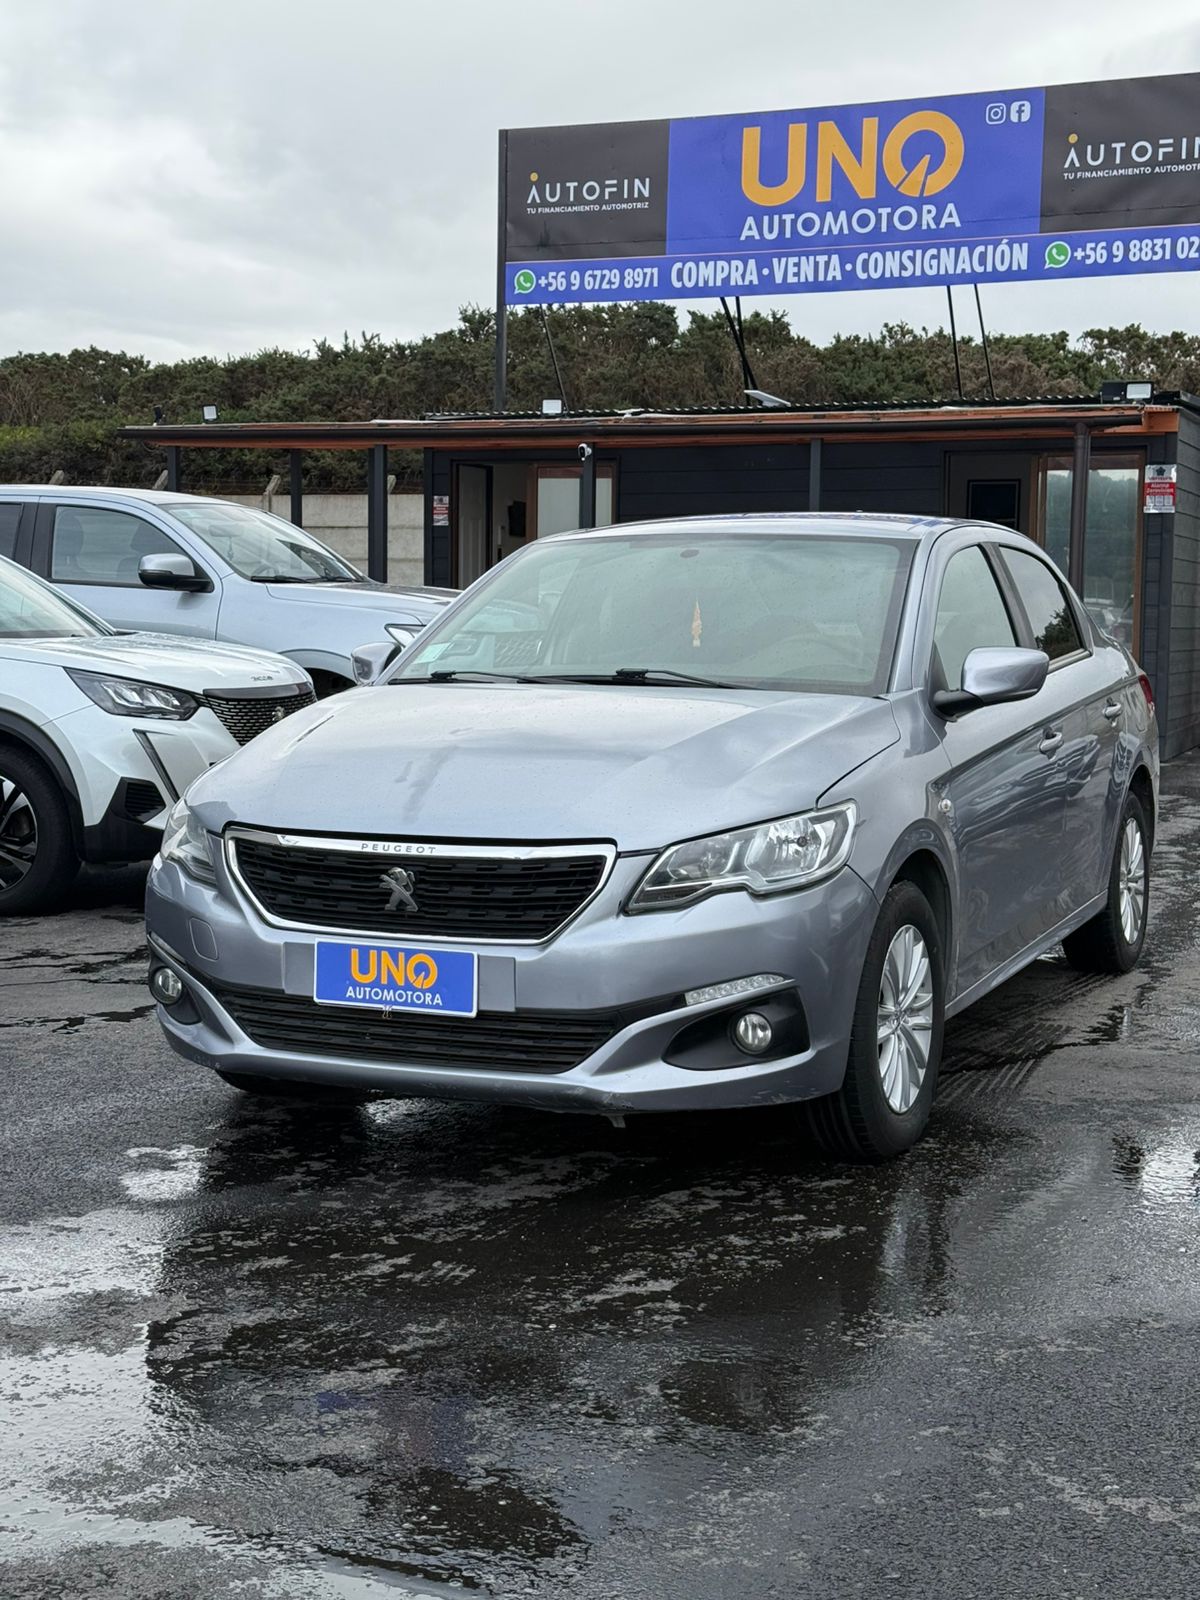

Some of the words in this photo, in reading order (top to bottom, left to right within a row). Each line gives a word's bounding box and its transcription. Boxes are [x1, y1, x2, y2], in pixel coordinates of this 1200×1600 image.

[741, 110, 965, 207] UNO
[1063, 172, 1075, 180] TU
[1077, 166, 1152, 178] FINANCIAMIENTO
[527, 177, 650, 204] AUTOFIN
[538, 204, 600, 214] FINANCIAMIENTO
[601, 202, 650, 211] AUTOMOTRIZ
[739, 202, 962, 241] AUTOMOTORA
[670, 258, 757, 289] COMPRA
[772, 254, 843, 285] VENTA
[855, 239, 1029, 280] CONSIGNACIÓN
[1073, 241, 1108, 265] +56
[1112, 240, 1124, 263] 9
[1128, 238, 1172, 262] 8831
[1176, 236, 1200, 260] 02
[538, 271, 567, 292] +56
[570, 270, 581, 291] 9
[584, 268, 620, 291] 6729
[624, 267, 659, 289] 8971
[361, 843, 437, 855] PEUGEOT
[351, 948, 438, 990] UNO
[346, 985, 443, 1007] AUTOMOTORA
